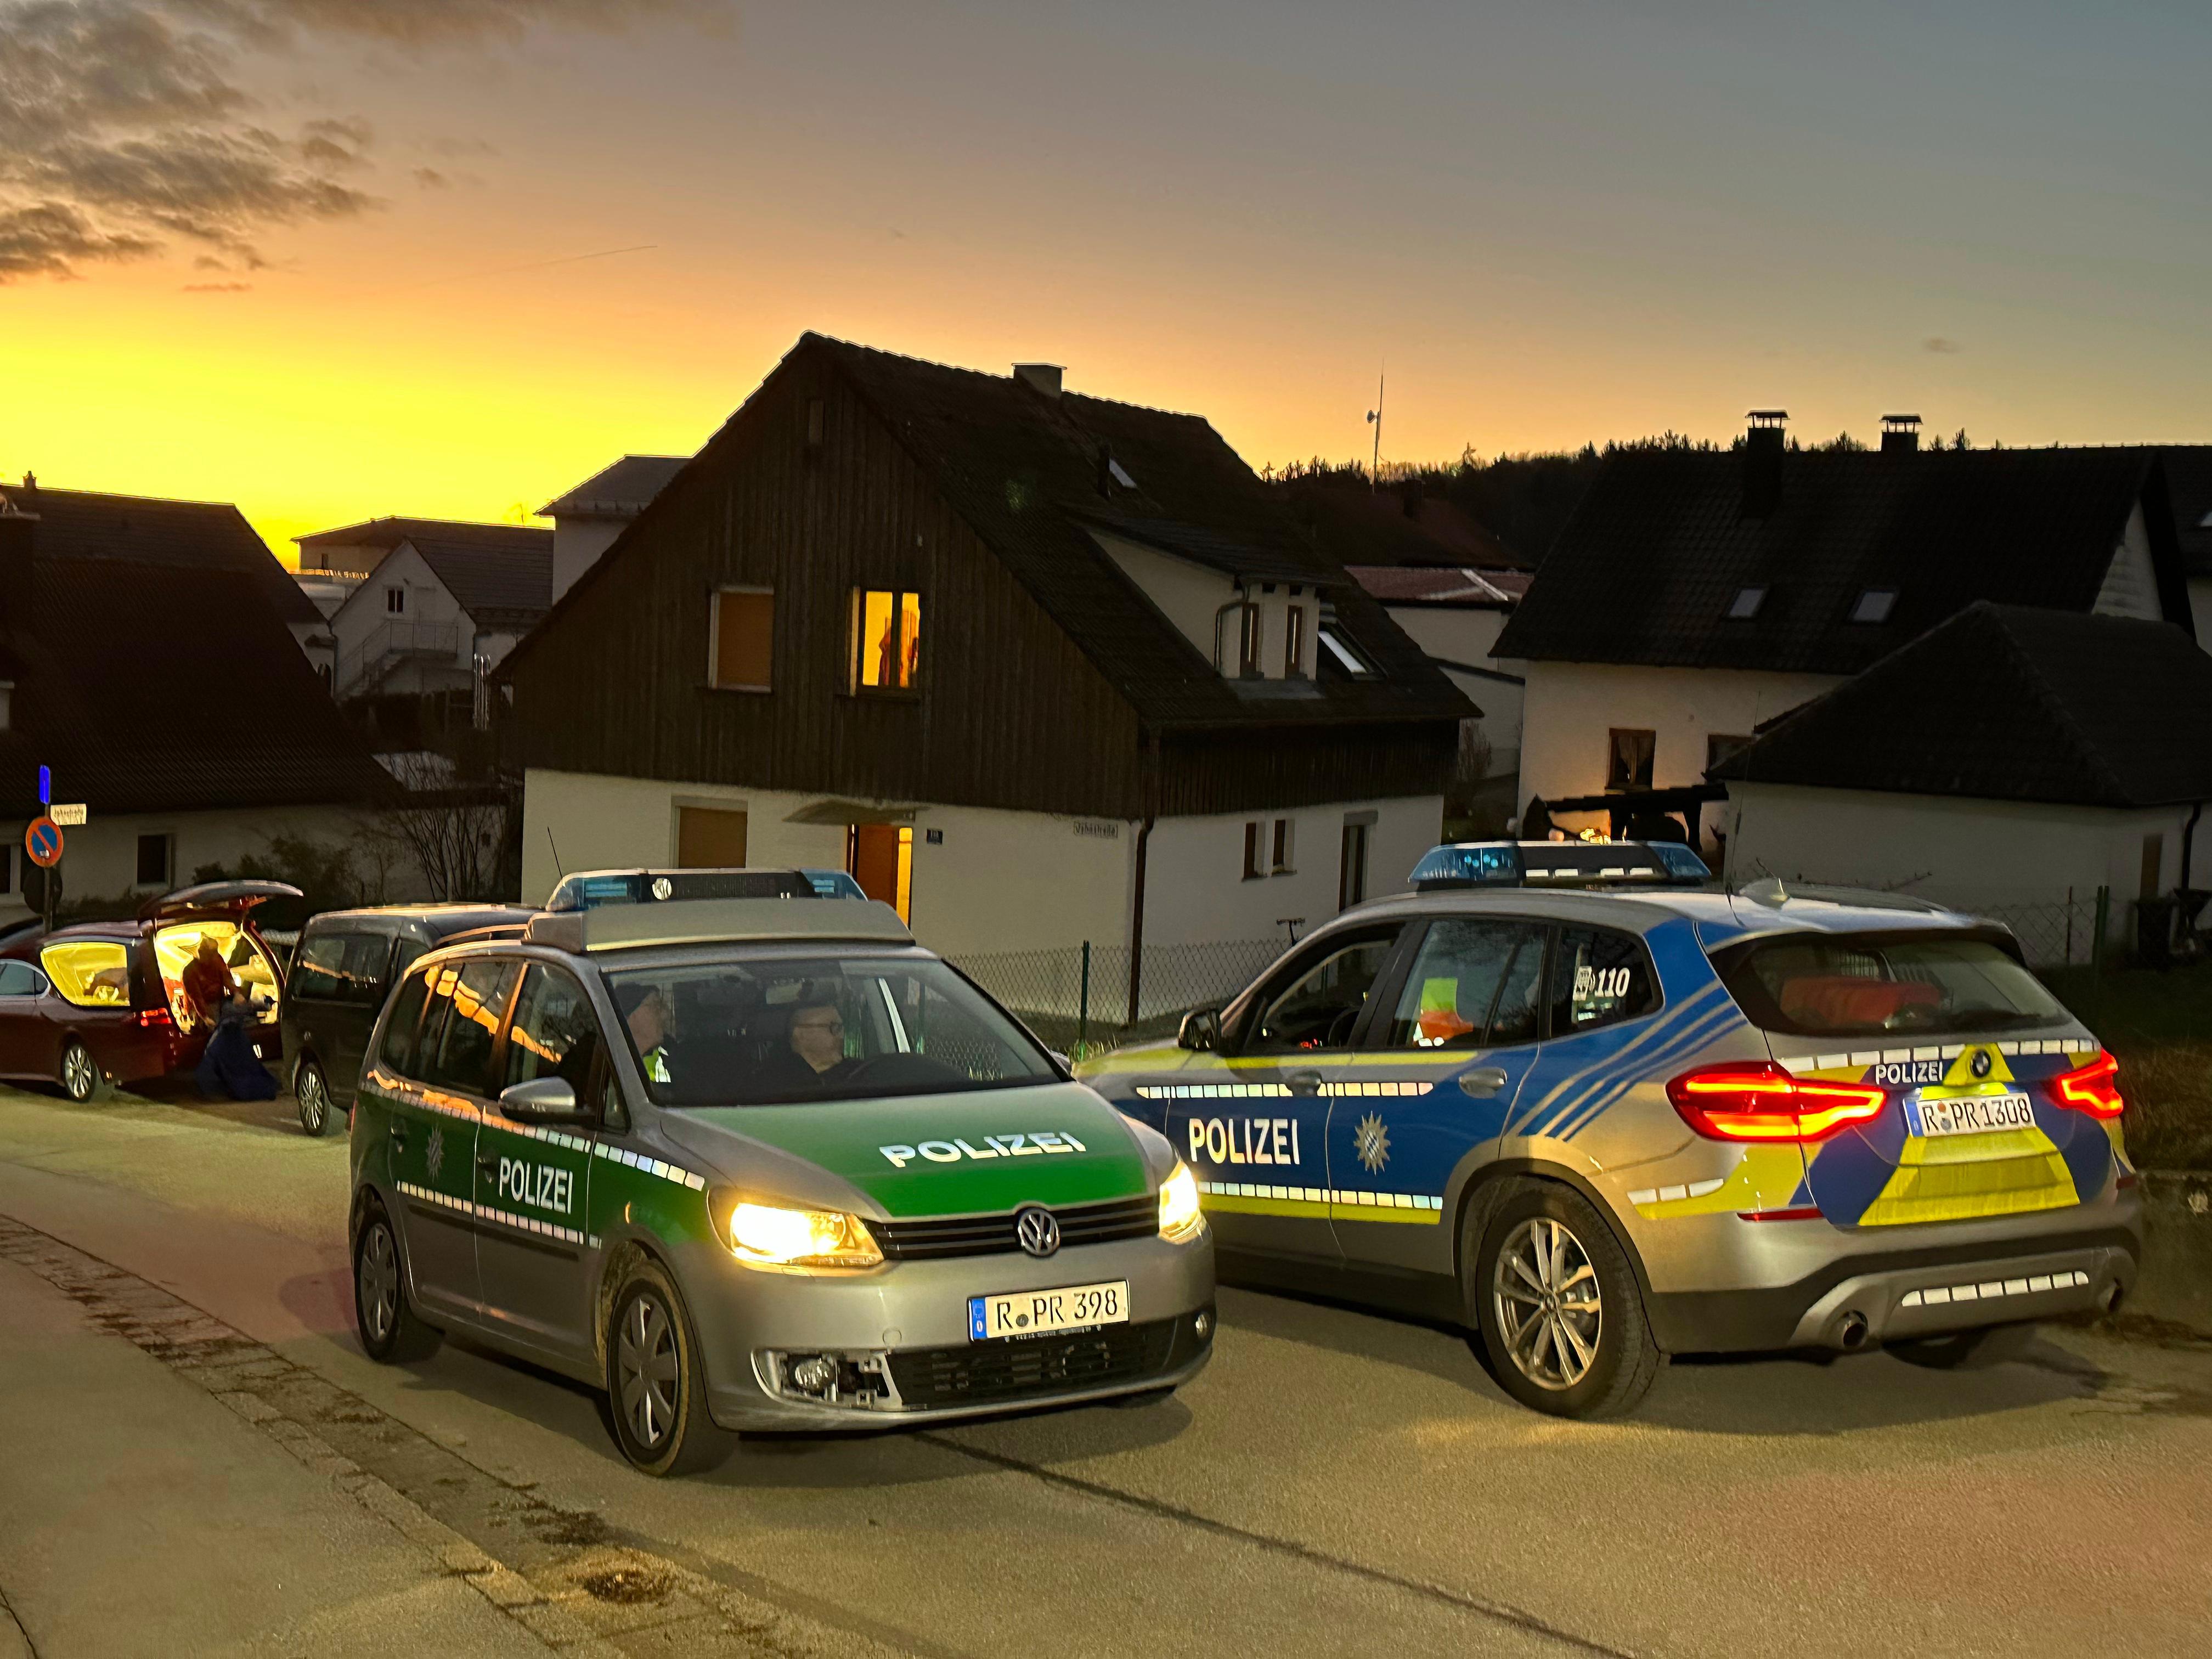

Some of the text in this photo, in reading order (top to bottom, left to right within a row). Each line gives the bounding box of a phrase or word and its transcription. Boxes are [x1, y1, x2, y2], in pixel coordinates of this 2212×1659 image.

[1594, 967, 1630, 997] 110
[1875, 1061, 1943, 1084] POLIZEI
[1922, 1098, 2030, 1132] R PR 1308
[879, 1132, 1086, 1167] POLIZEI
[1189, 1118, 1300, 1165] POLIZEI
[499, 1156, 573, 1215] POLIZEI
[996, 1301, 1013, 1330] R
[1032, 1296, 1064, 1326] PR
[1074, 1289, 1118, 1319] 398
